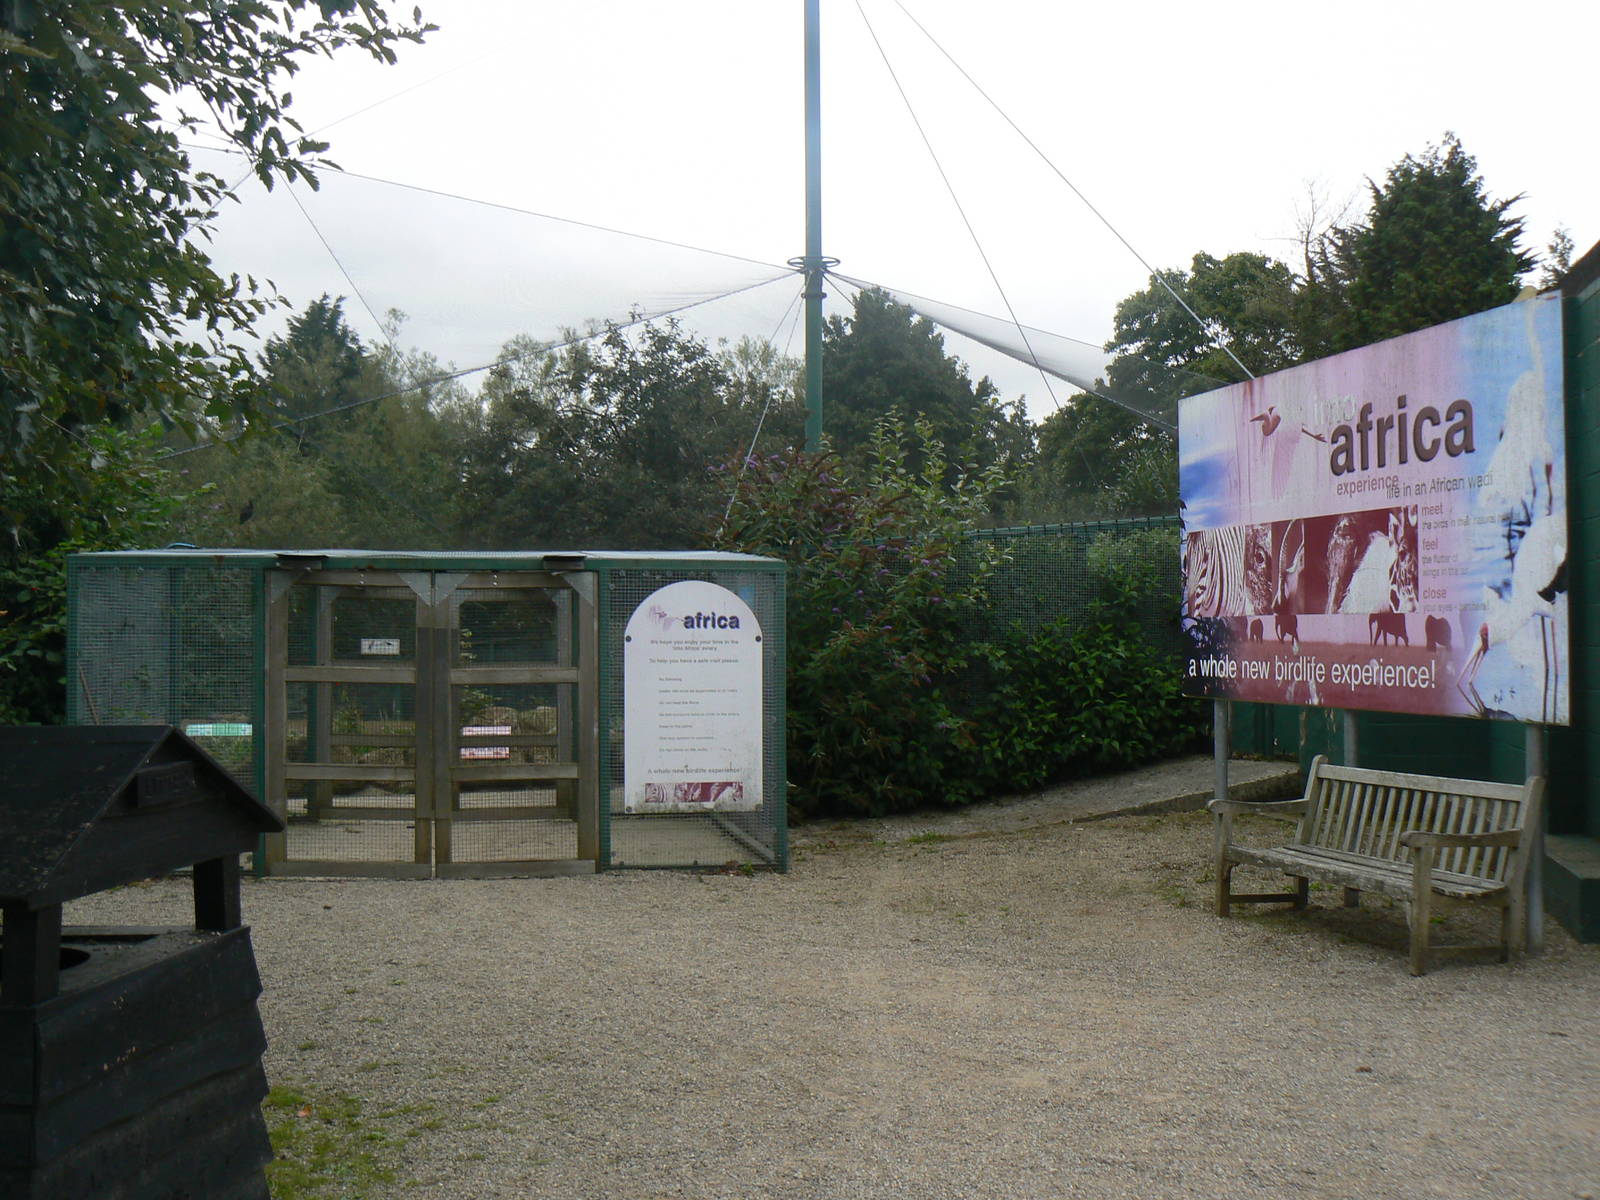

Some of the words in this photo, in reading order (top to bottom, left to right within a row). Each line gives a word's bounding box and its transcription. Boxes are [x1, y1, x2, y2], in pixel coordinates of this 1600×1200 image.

[1330, 394, 1476, 476] africa
[1337, 473, 1400, 498] experience
[1386, 483, 1400, 499] life
[1403, 482, 1412, 497] in
[1415, 483, 1428, 496] an
[1429, 476, 1464, 494] African
[1421, 502, 1443, 516] meet
[1422, 537, 1438, 551] feel
[1423, 587, 1447, 600] close
[684, 611, 740, 629] africa
[1188, 657, 1197, 678] a
[1199, 654, 1237, 679] whole
[1241, 660, 1270, 680] new
[1275, 655, 1325, 683] birdlife
[1331, 658, 1436, 691] experience!
